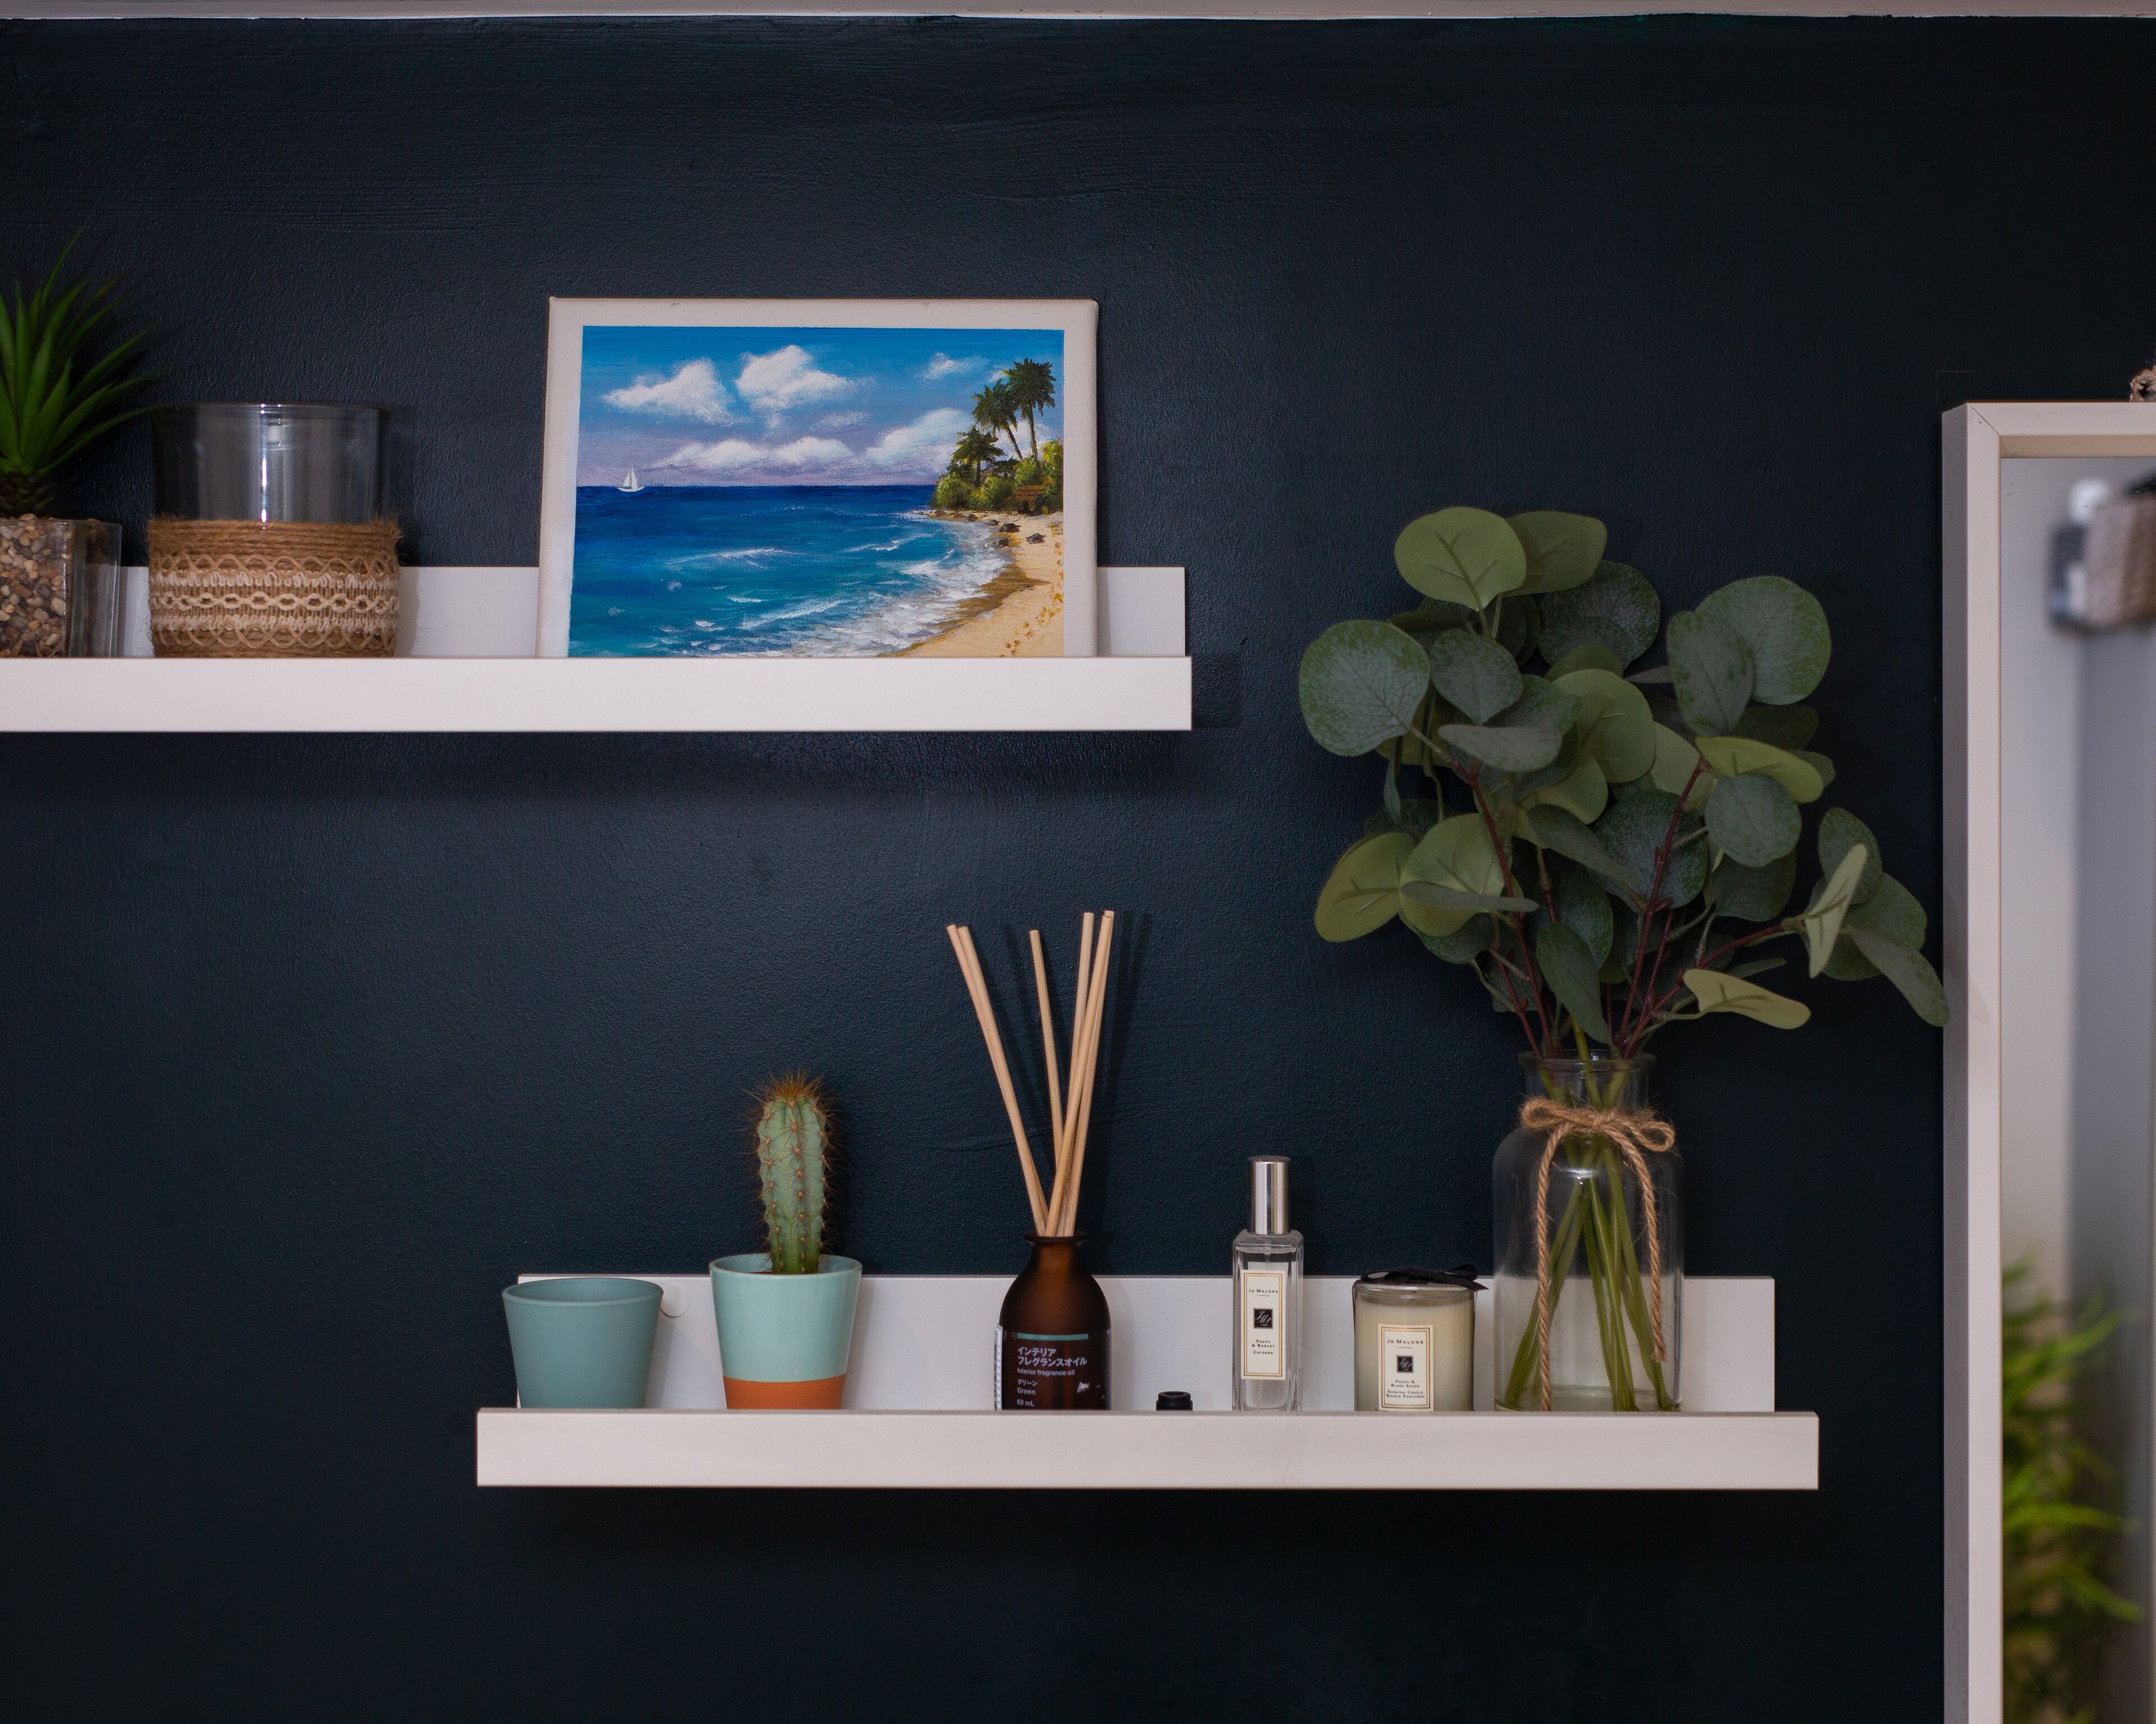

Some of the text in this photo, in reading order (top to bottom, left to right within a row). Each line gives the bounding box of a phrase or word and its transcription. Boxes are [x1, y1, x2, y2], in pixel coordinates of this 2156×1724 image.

[1017, 1346, 1056, 1357] インテリア
[1017, 1356, 1087, 1366] フレグランスオイル
